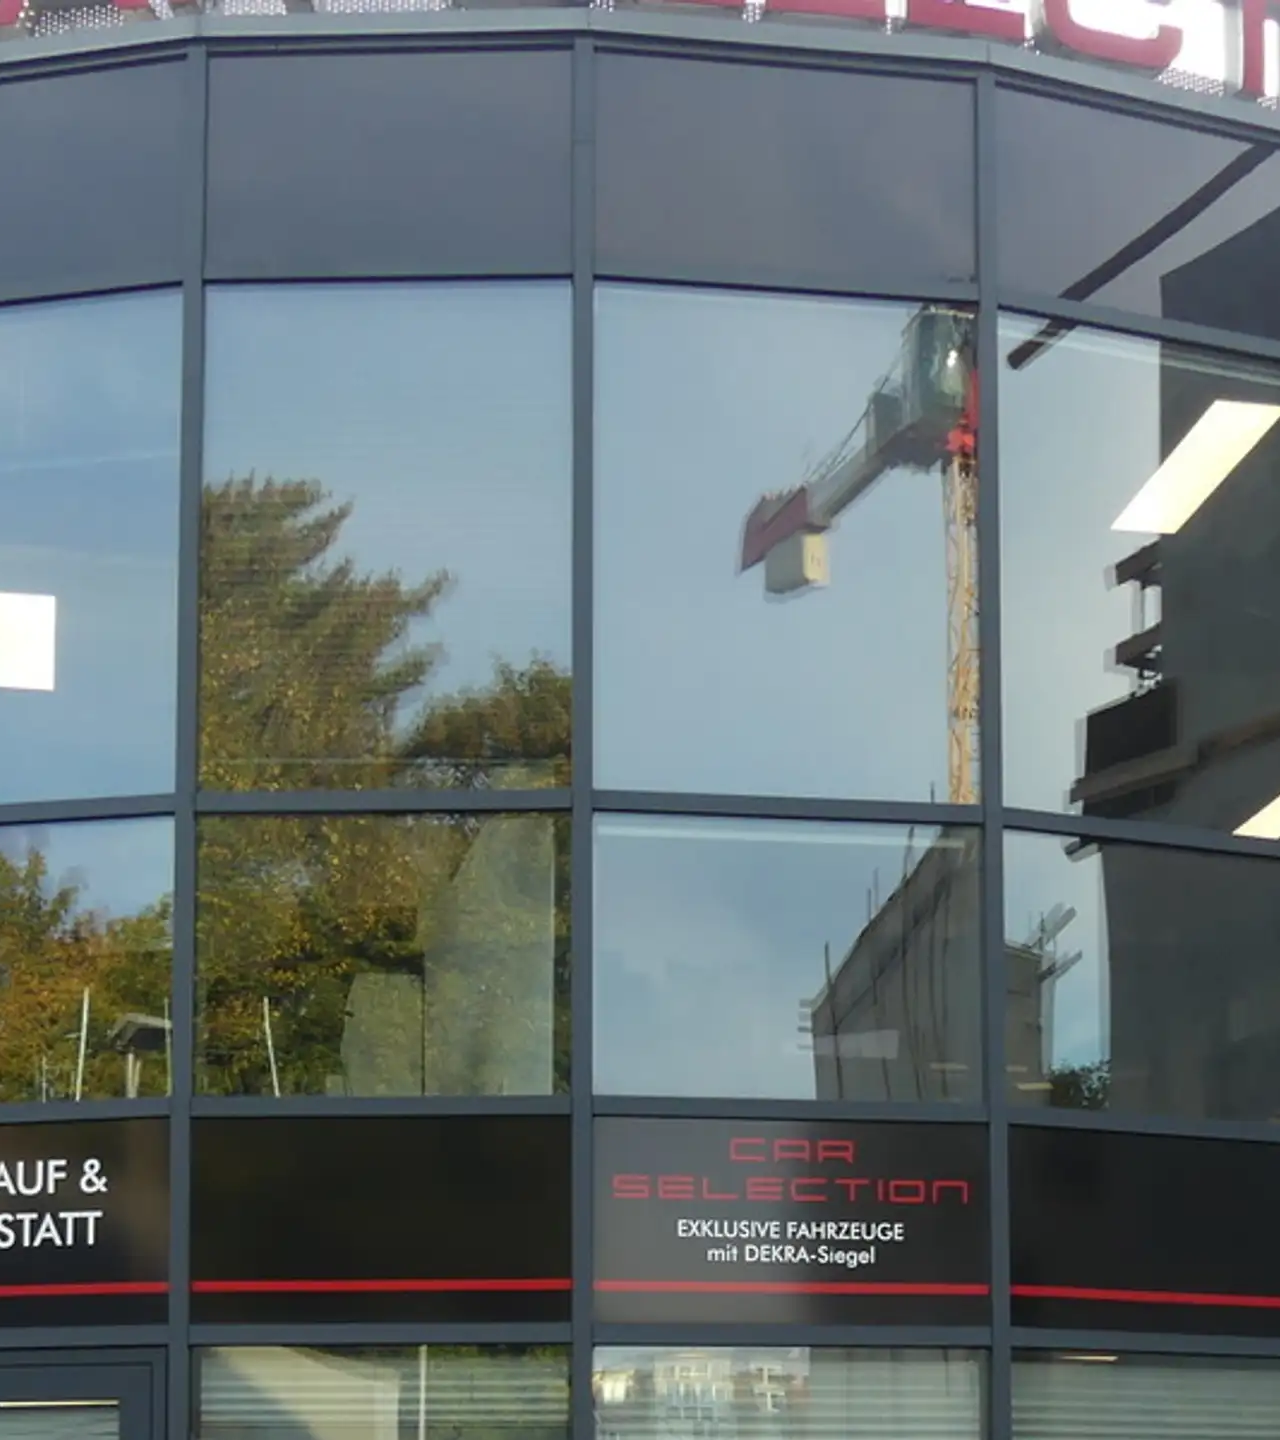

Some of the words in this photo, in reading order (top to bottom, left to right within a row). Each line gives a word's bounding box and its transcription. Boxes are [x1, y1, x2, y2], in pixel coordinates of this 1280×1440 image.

[729, 1138, 855, 1163] CAR
[80, 1158, 108, 1194] &
[612, 1174, 972, 1205] SELECTION
[676, 1218, 781, 1240] EXKLUSIVE
[786, 1220, 905, 1242] FAHRZEUGE
[707, 1244, 739, 1263] mit
[744, 1244, 876, 1268] DEKRA-Siegel
